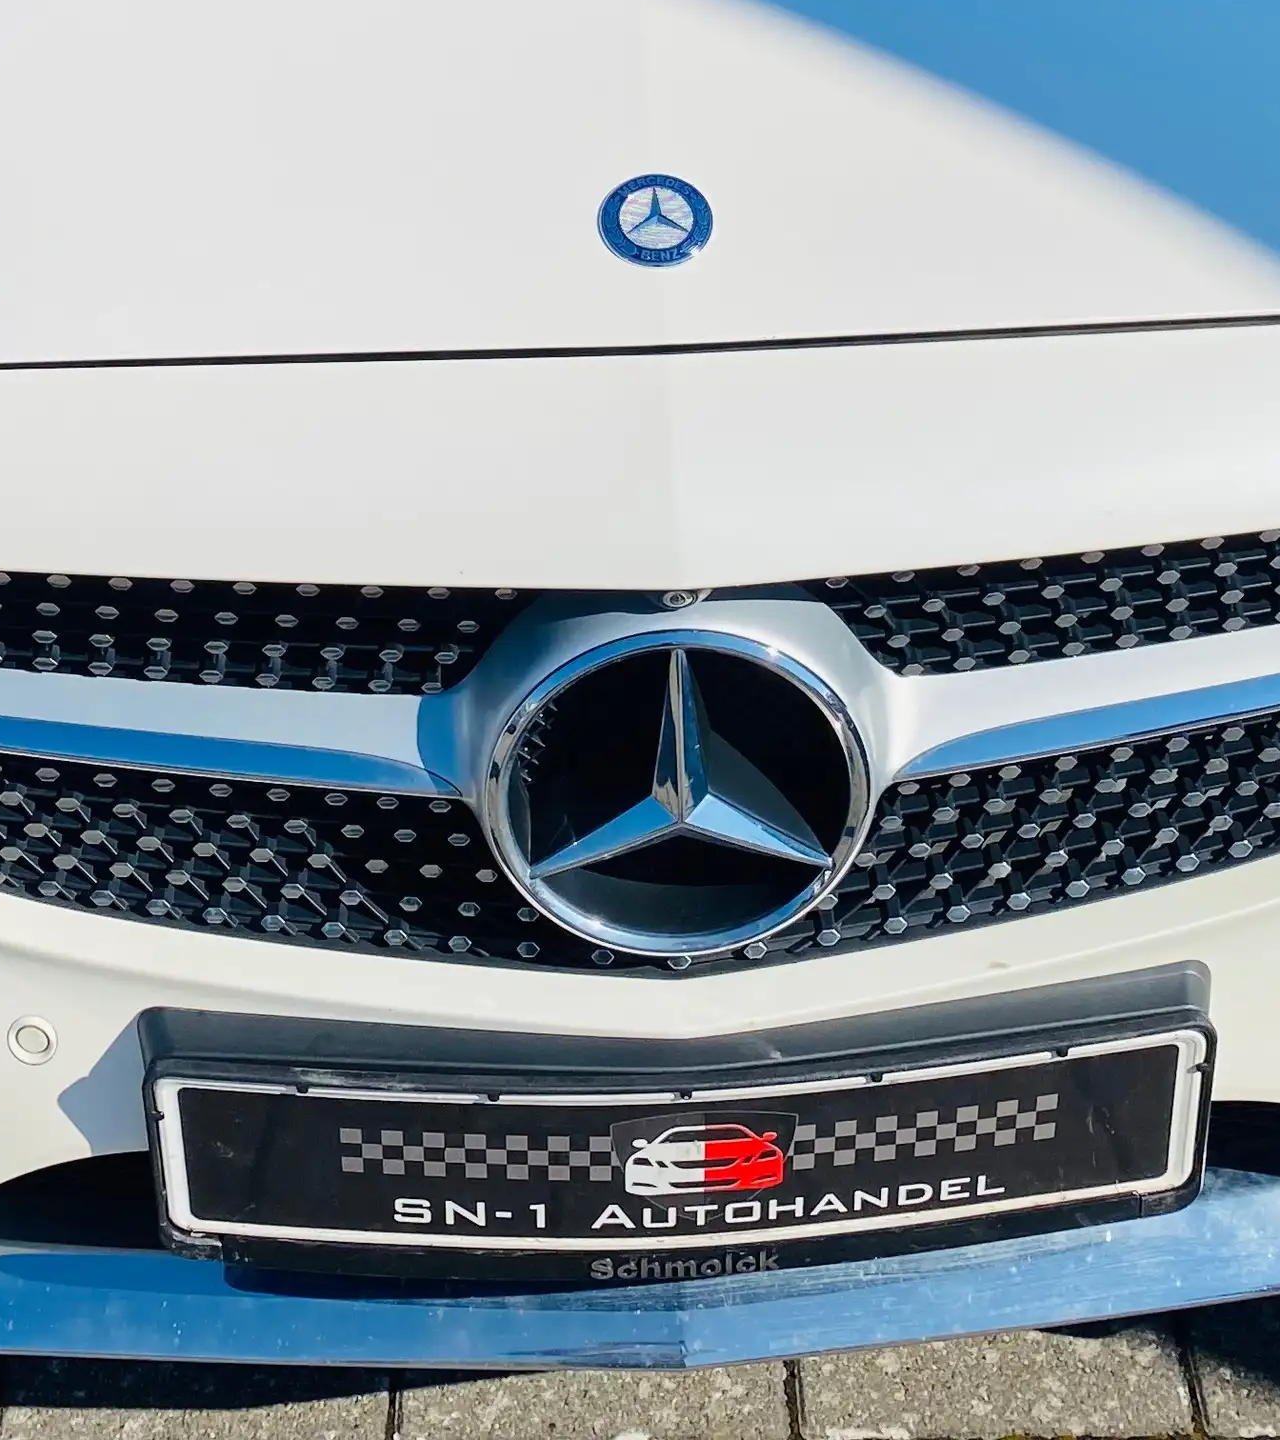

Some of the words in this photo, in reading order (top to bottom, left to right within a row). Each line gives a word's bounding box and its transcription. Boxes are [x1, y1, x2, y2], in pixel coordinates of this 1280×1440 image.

[616, 175, 691, 197] MERCEDES
[640, 248, 681, 262] BENZ
[392, 1196, 548, 1229] SN-1
[590, 1174, 1006, 1230] AUTOHANDEL
[589, 1250, 780, 1281] Schmolck
